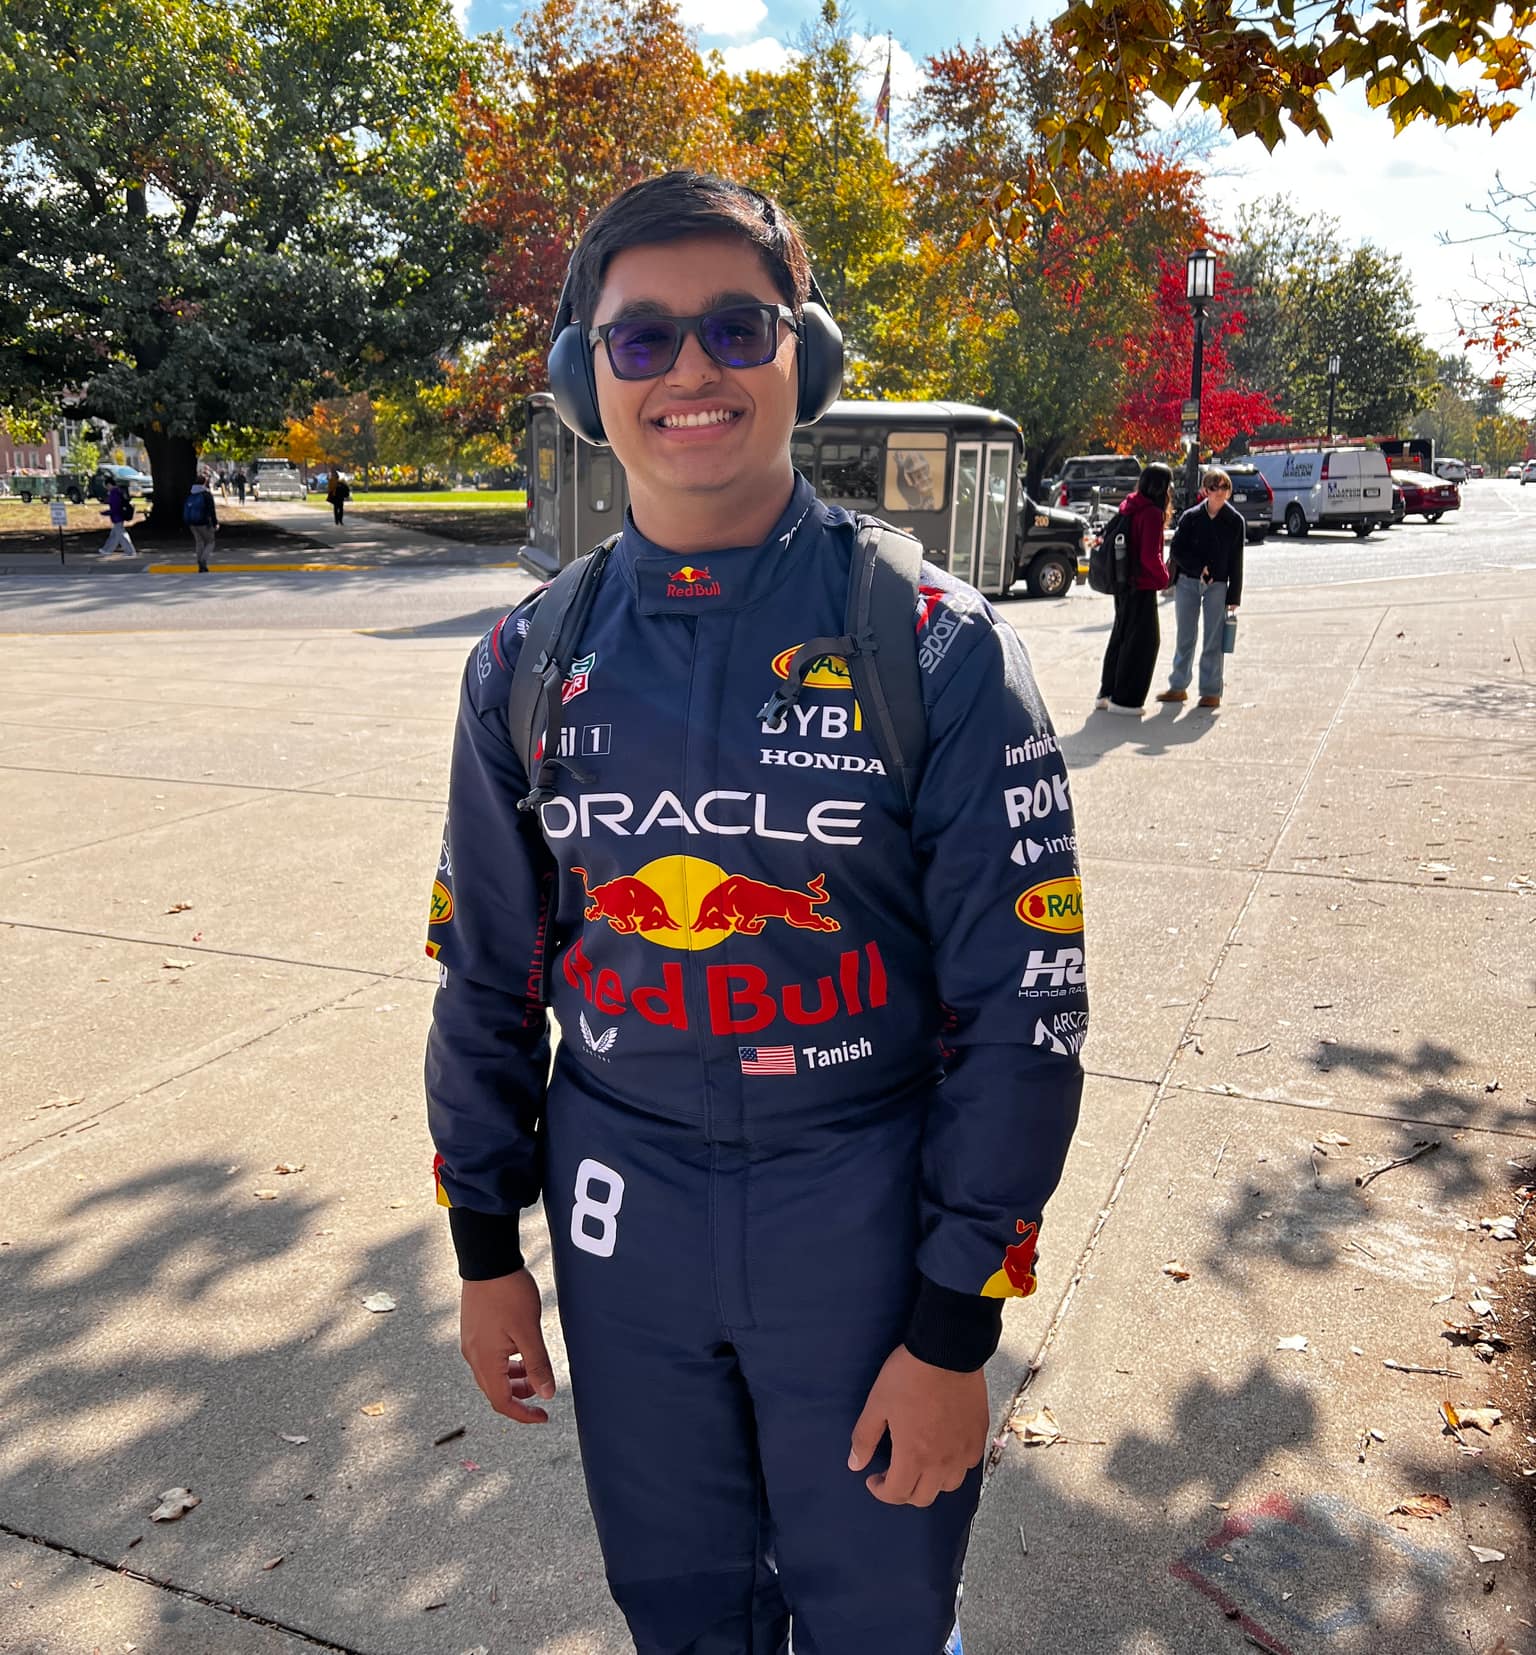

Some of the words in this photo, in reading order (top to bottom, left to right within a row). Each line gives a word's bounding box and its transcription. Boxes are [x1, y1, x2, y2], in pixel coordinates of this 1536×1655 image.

[1034, 515, 1049, 527] 200
[666, 583, 693, 597] Red
[695, 580, 721, 596] Bull
[760, 748, 887, 776] HONDA
[1004, 735, 1058, 767] infinit
[541, 790, 867, 846] ORACLE
[563, 936, 688, 1031] Red
[706, 940, 888, 1036] Bull
[1018, 988, 1067, 998] Honda
[802, 1037, 873, 1069] Tanish
[570, 1158, 625, 1258] 8
